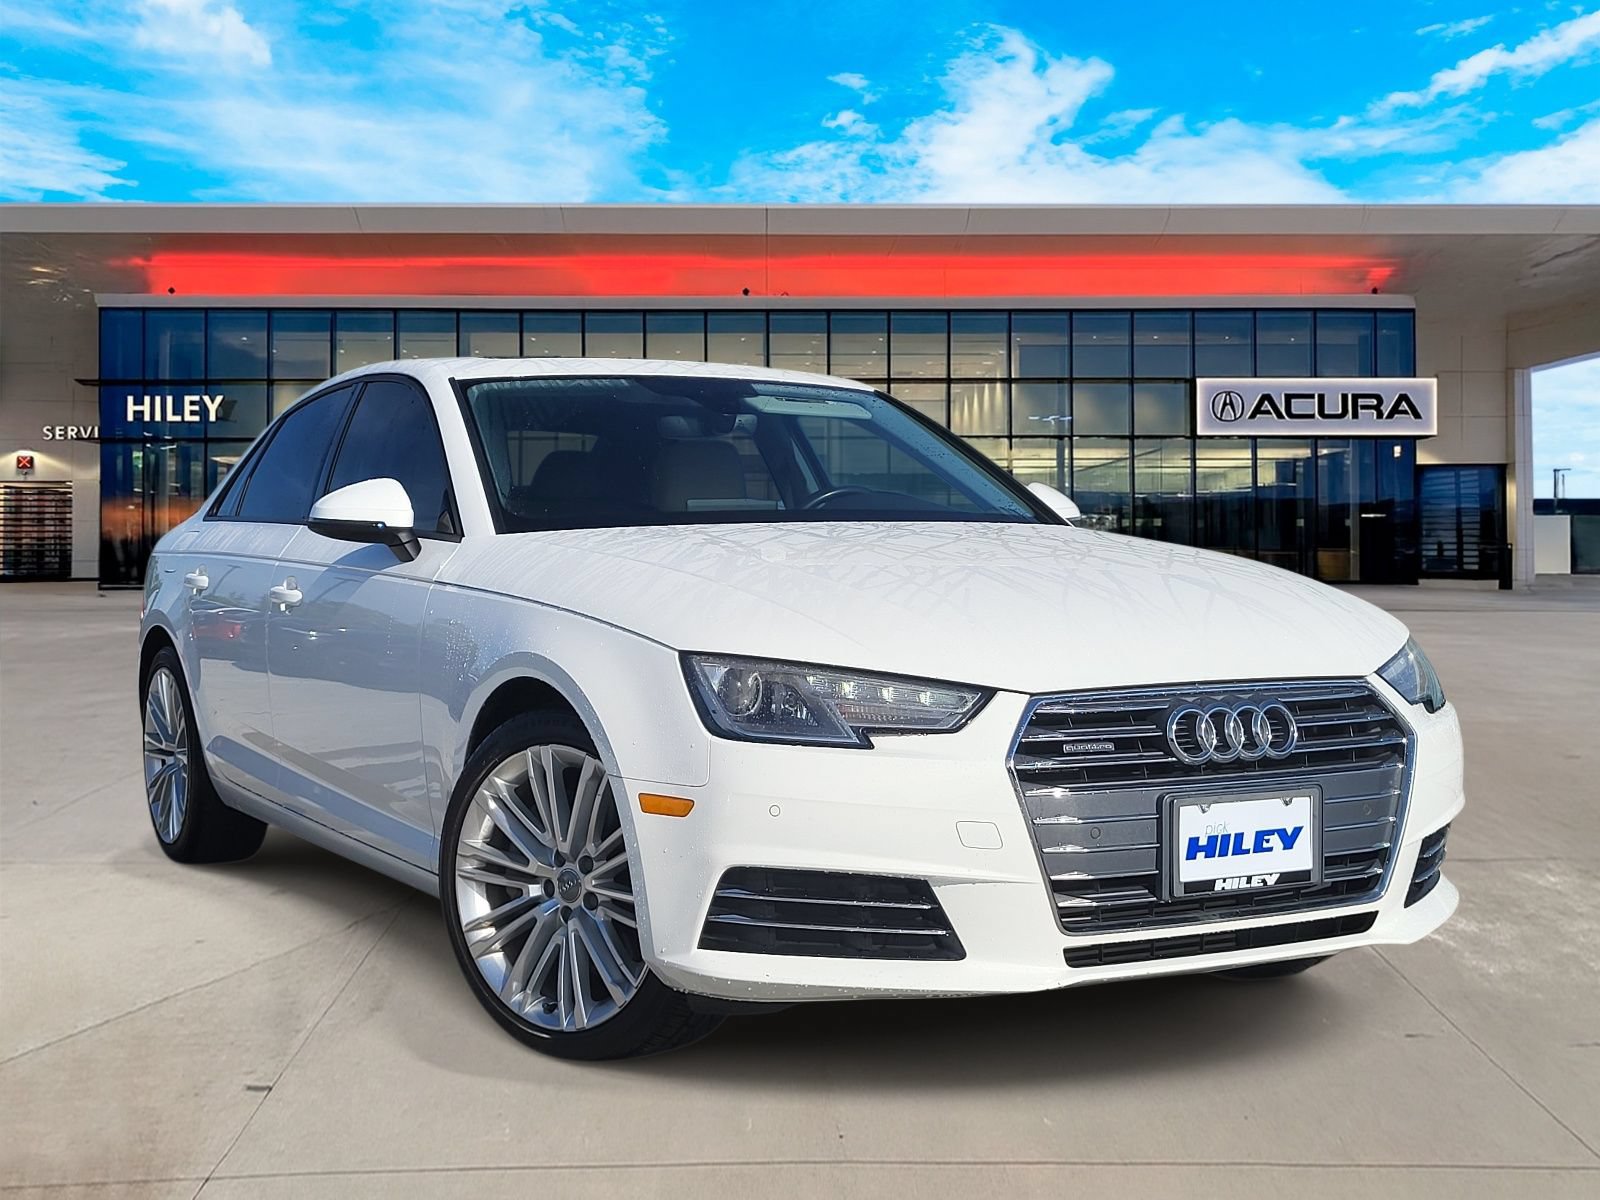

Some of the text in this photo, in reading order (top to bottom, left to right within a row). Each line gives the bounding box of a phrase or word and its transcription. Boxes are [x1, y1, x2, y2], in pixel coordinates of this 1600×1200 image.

[126, 395, 224, 423] HILEY
[1247, 393, 1423, 420] ACURA
[42, 425, 99, 440] SERVI
[1185, 826, 1304, 861] HILEY
[1214, 873, 1281, 892] HILEY
